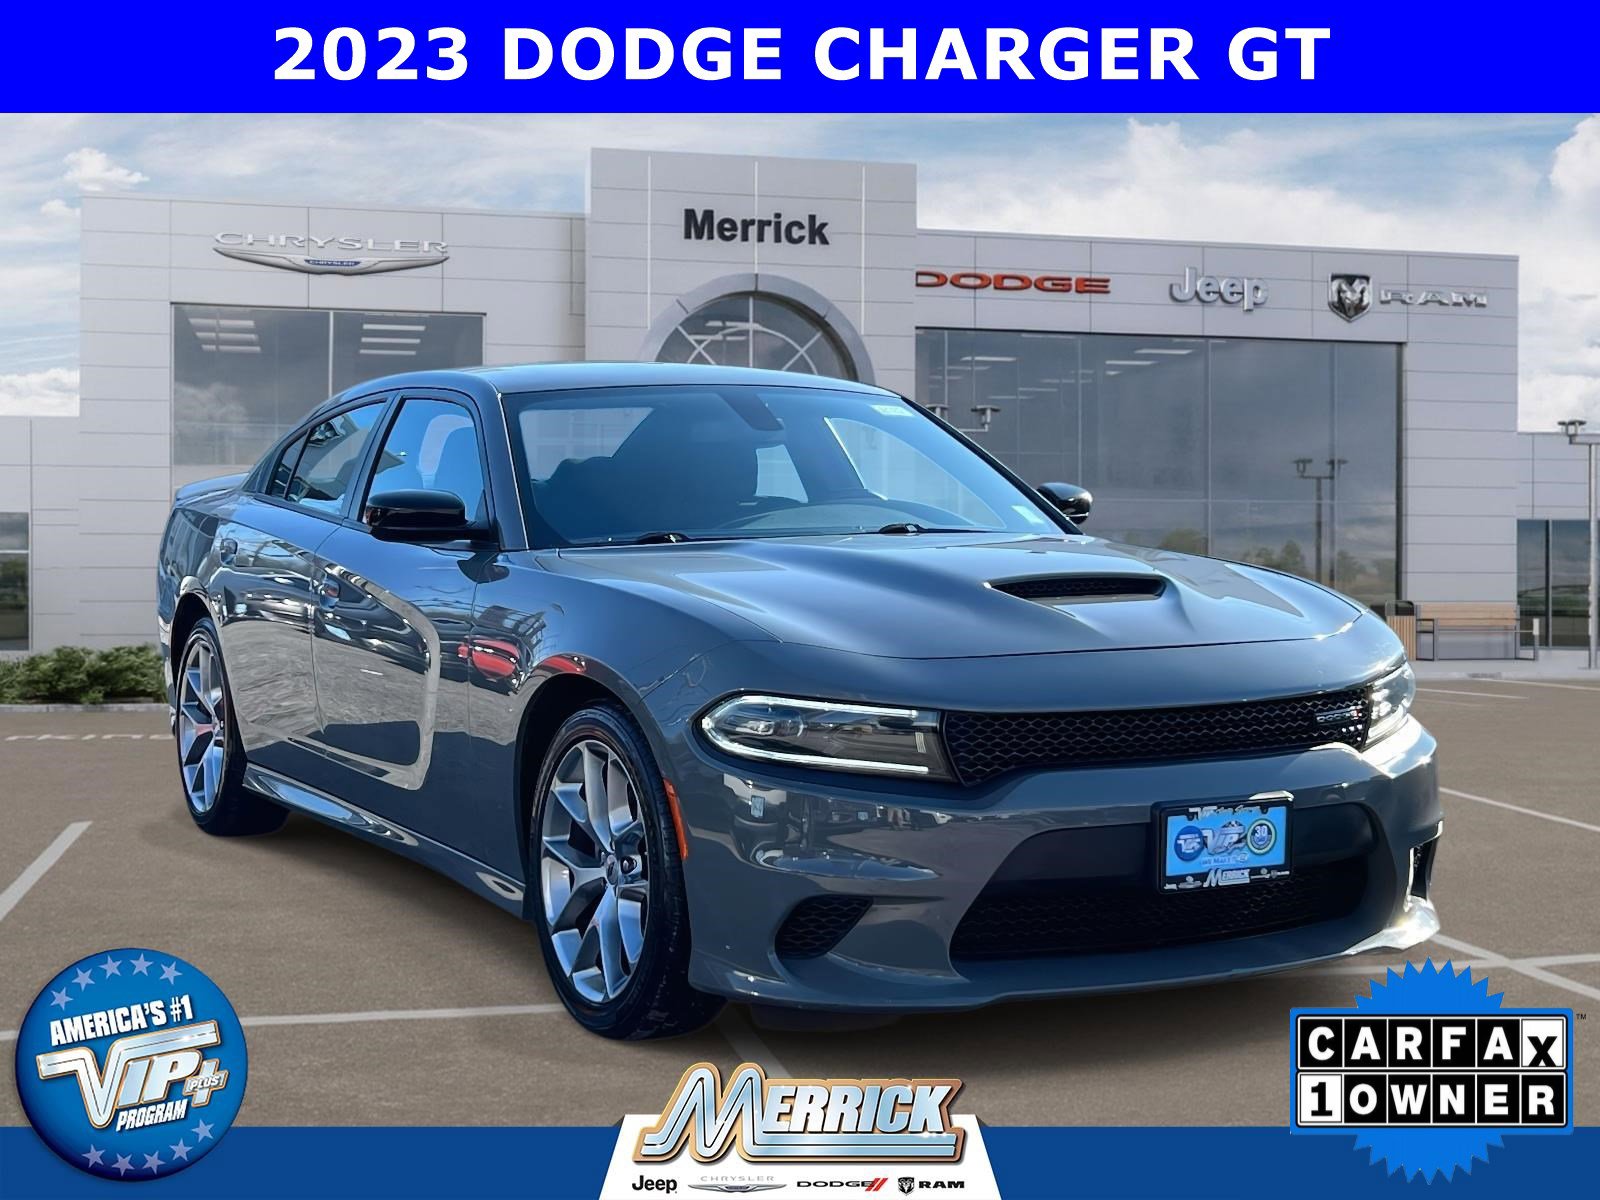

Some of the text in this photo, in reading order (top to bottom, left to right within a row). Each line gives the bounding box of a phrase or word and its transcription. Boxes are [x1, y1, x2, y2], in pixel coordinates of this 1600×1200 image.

[683, 208, 830, 246] Merrick
[213, 231, 449, 254] CHRYSLER
[915, 270, 1111, 294] DODGE
[1169, 264, 1270, 312] Jeep
[1379, 289, 1488, 308] RAM
